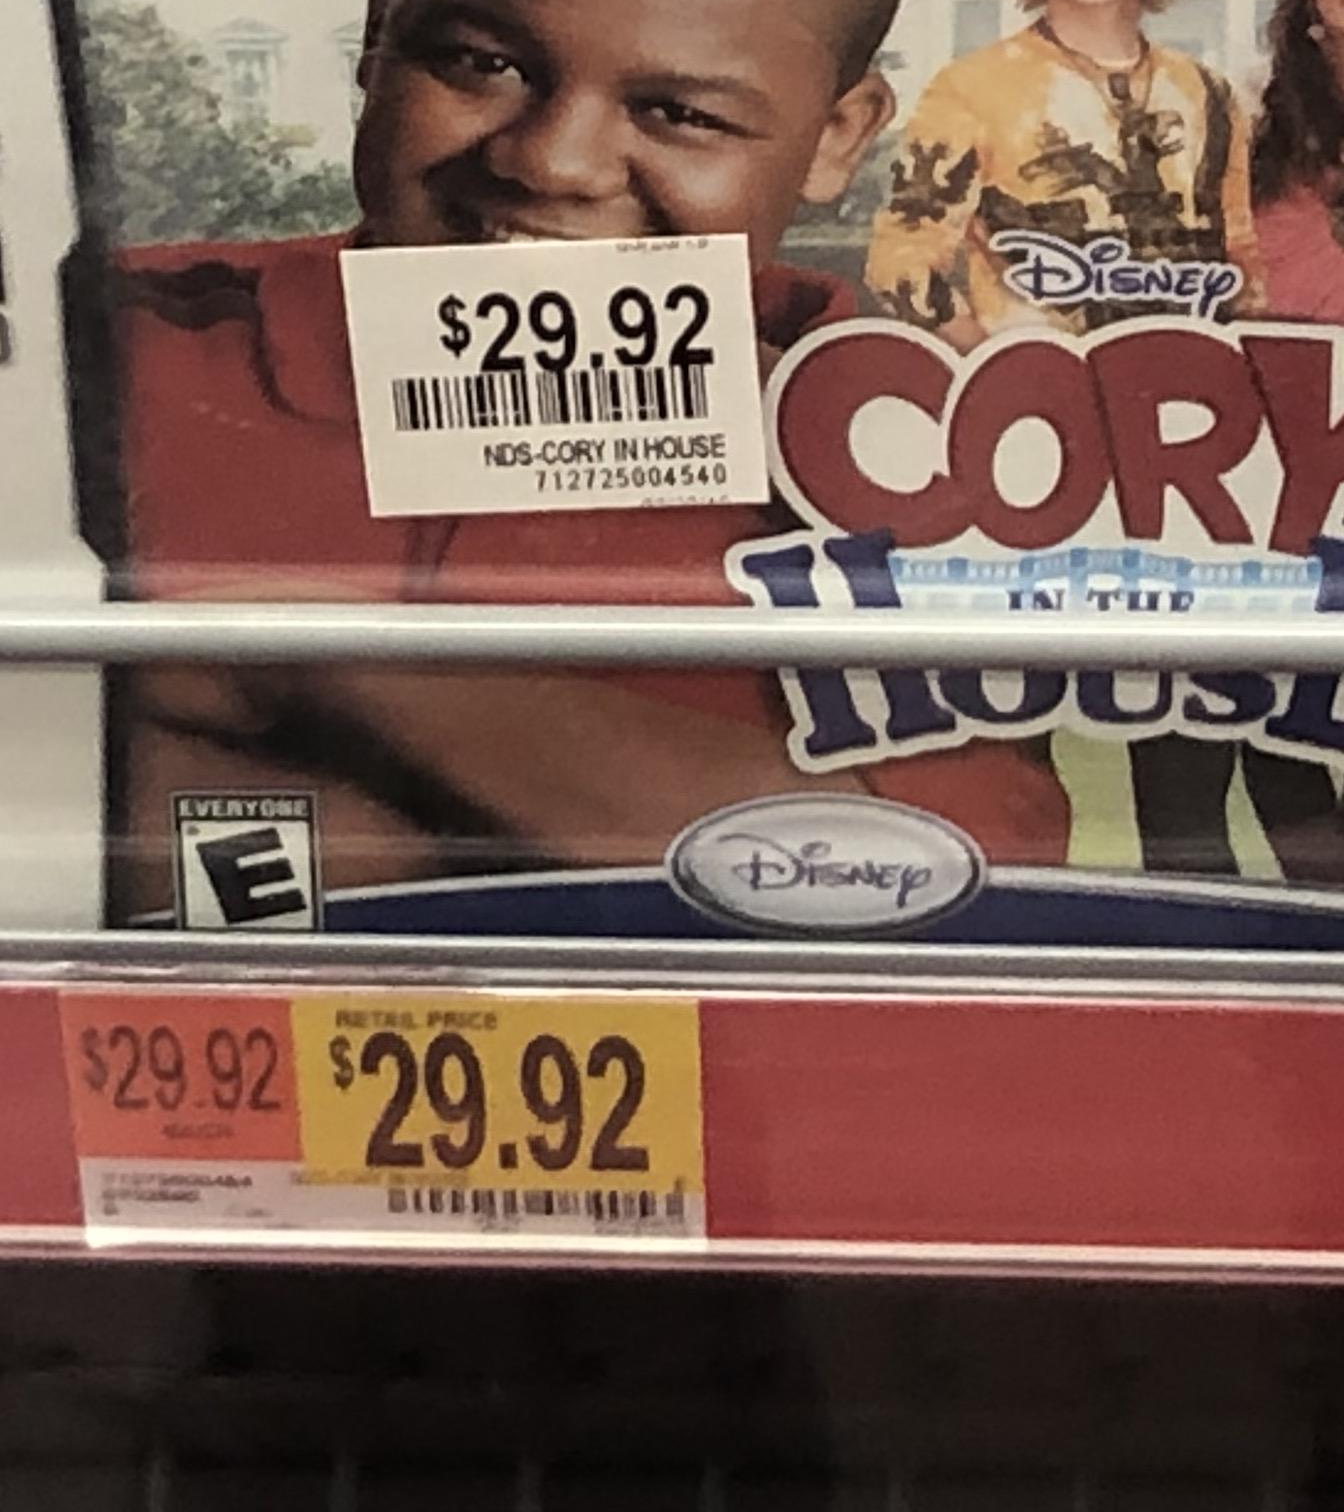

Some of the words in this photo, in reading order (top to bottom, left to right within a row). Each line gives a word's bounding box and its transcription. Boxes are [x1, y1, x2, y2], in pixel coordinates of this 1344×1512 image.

[439, 285, 714, 373] $29.92
[484, 439, 606, 467] NDS-CORY
[614, 438, 639, 462] IN
[643, 433, 726, 462] HOUSE
[536, 462, 727, 492] 712725004540
[179, 799, 310, 817] EVERYONE
[195, 826, 307, 926] E
[81, 1025, 282, 1111] $29.92
[329, 1031, 650, 1172] $29.92
